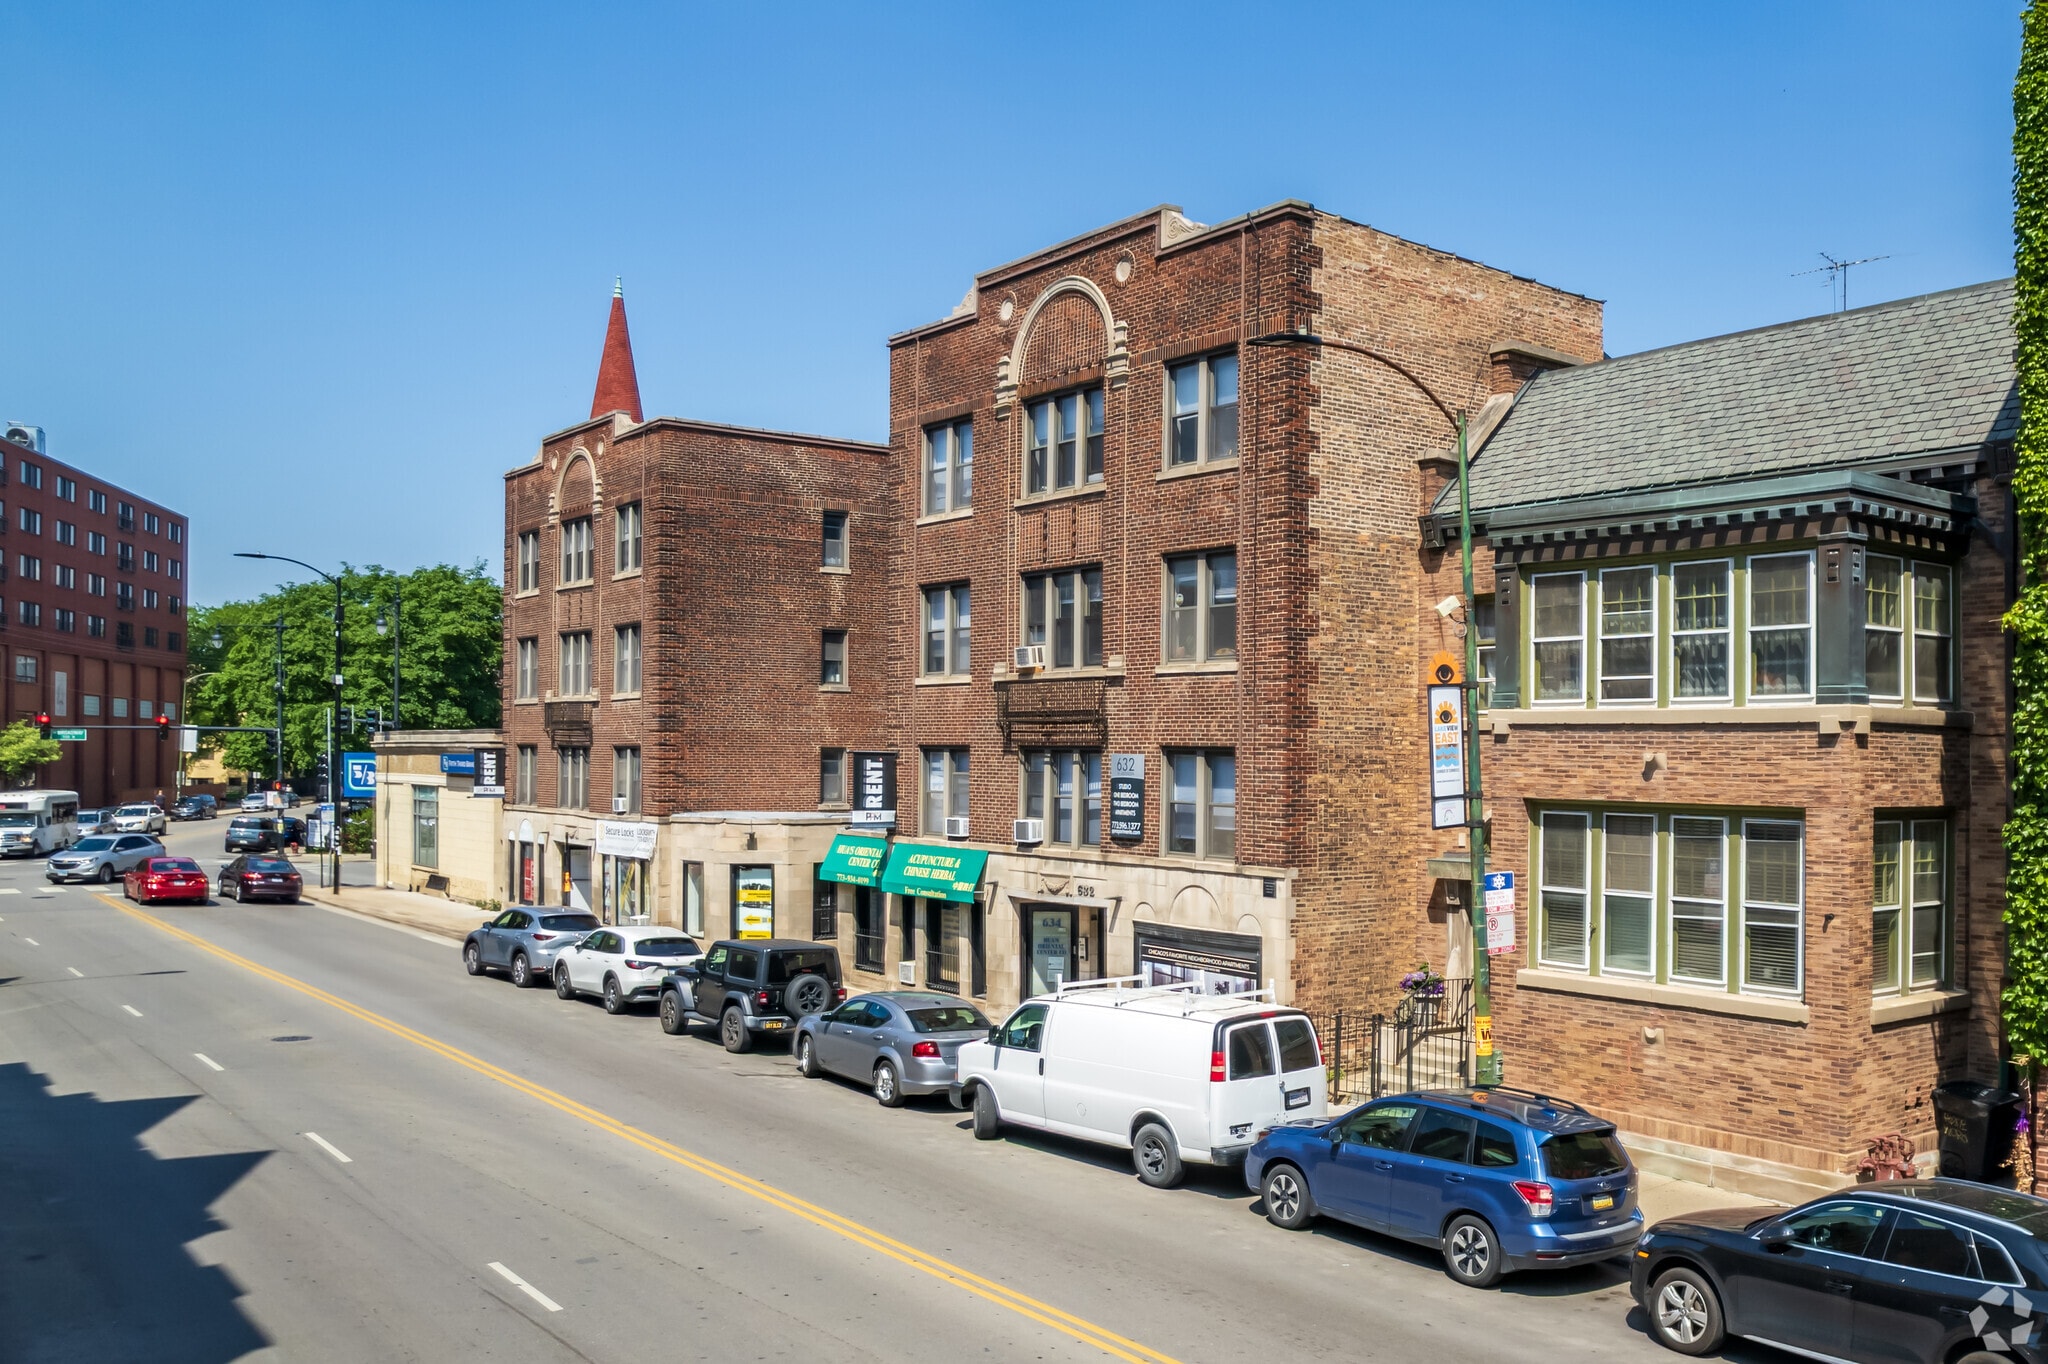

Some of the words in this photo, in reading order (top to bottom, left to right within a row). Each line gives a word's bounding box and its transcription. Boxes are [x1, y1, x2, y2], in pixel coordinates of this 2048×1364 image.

[1435, 732, 1458, 743] EAST
[1117, 758, 1135, 771] 632
[606, 826, 620, 836] Secure
[621, 827, 634, 837] Locks
[855, 846, 883, 858] ORIENTAL
[848, 856, 871, 868] CENTER
[908, 854, 954, 868] ACUPUNCTURE
[955, 858, 961, 868] &
[903, 866, 931, 878] CHINESE
[930, 868, 956, 881] HERBAL
[905, 886, 915, 895] Free
[917, 887, 946, 899] Consultation
[1042, 918, 1061, 927] 634
[1168, 951, 1187, 960] FAVORITE
[1188, 955, 1222, 966] NEIGHBORHOOD
[1222, 960, 1250, 969] APARTMENTS
